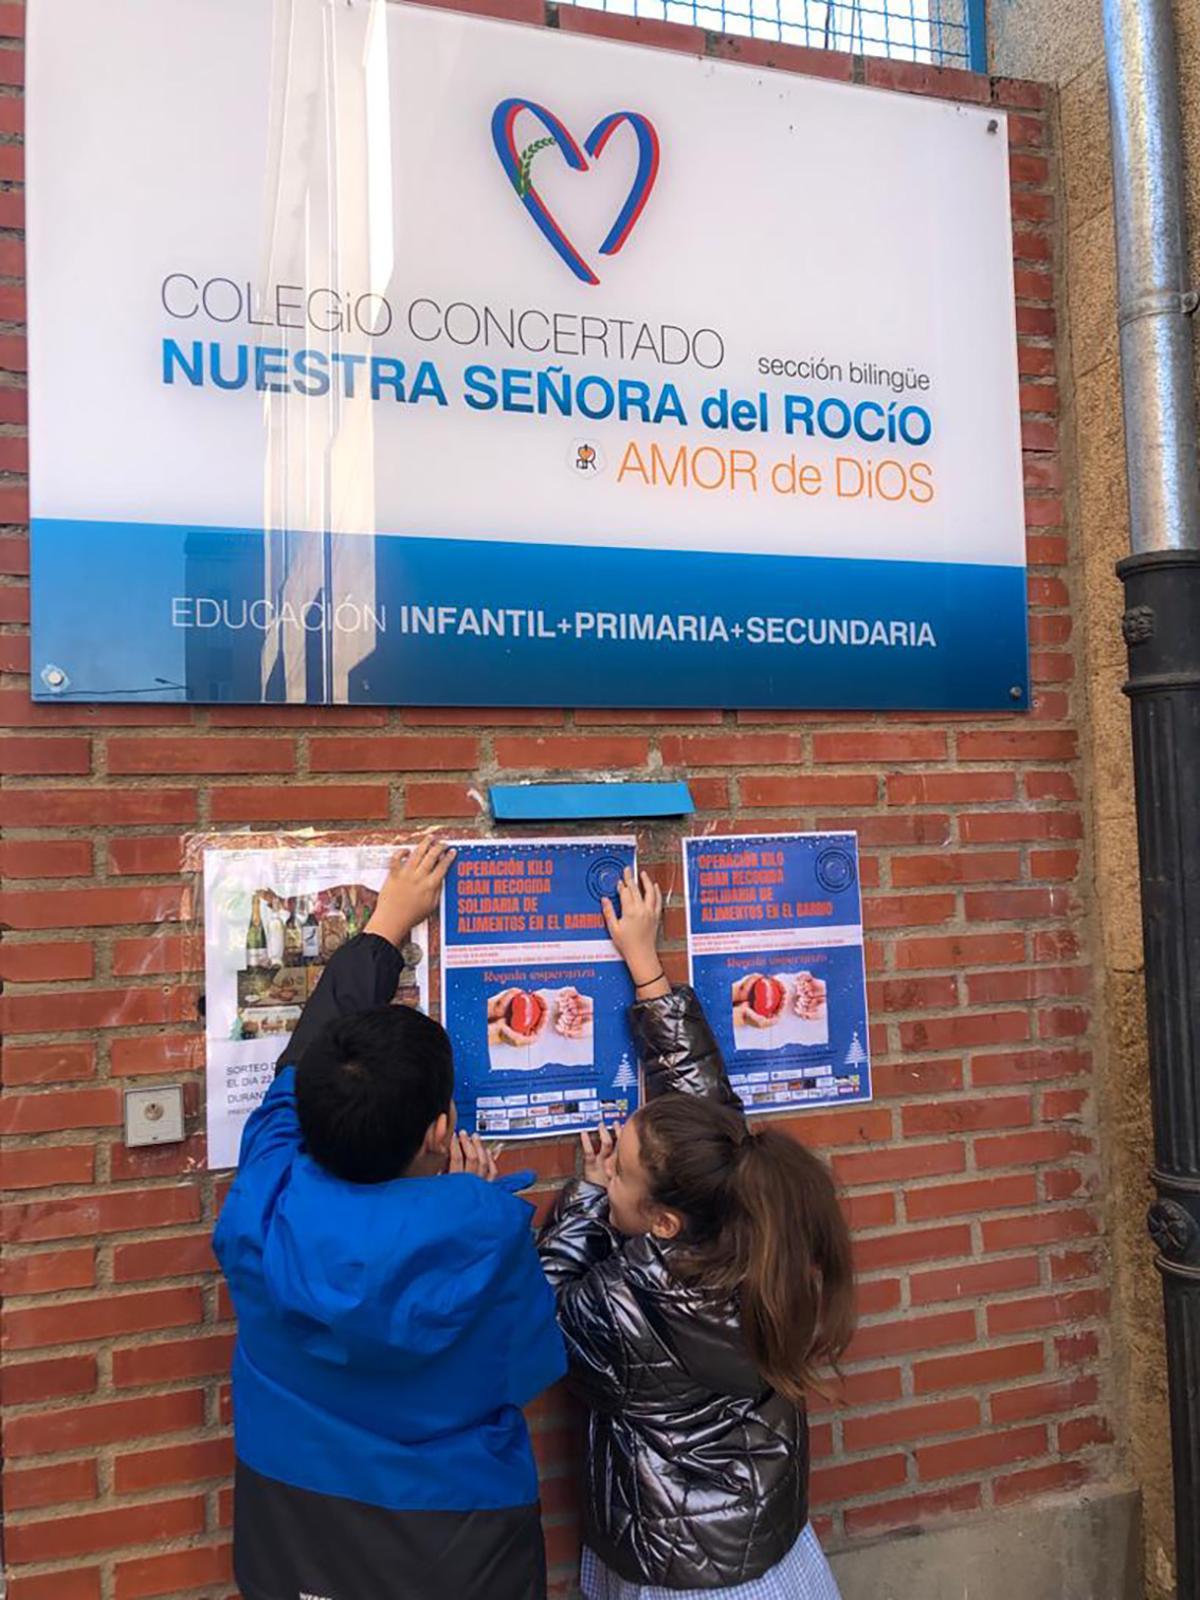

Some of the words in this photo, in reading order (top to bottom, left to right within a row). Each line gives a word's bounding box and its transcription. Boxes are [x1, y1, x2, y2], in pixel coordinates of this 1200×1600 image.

[408, 298, 724, 369] CONCERTADO
[162, 338, 448, 406] NUESTRA
[463, 364, 688, 428] SEÑORA
[701, 388, 768, 433] del
[758, 356, 842, 383] sección
[849, 362, 930, 393] bilingüe
[617, 441, 758, 492] AMOR
[771, 454, 822, 495] de
[172, 594, 387, 633] EDUCACIÓN
[458, 859, 525, 876] OPERACIÓN
[528, 859, 554, 874] KILO
[458, 879, 490, 895] GRAN
[494, 878, 551, 894] RECOGIDA
[458, 914, 526, 933] ALIMENTOS
[227, 1063, 269, 1076] SORTEO
[227, 1079, 239, 1088] EL
